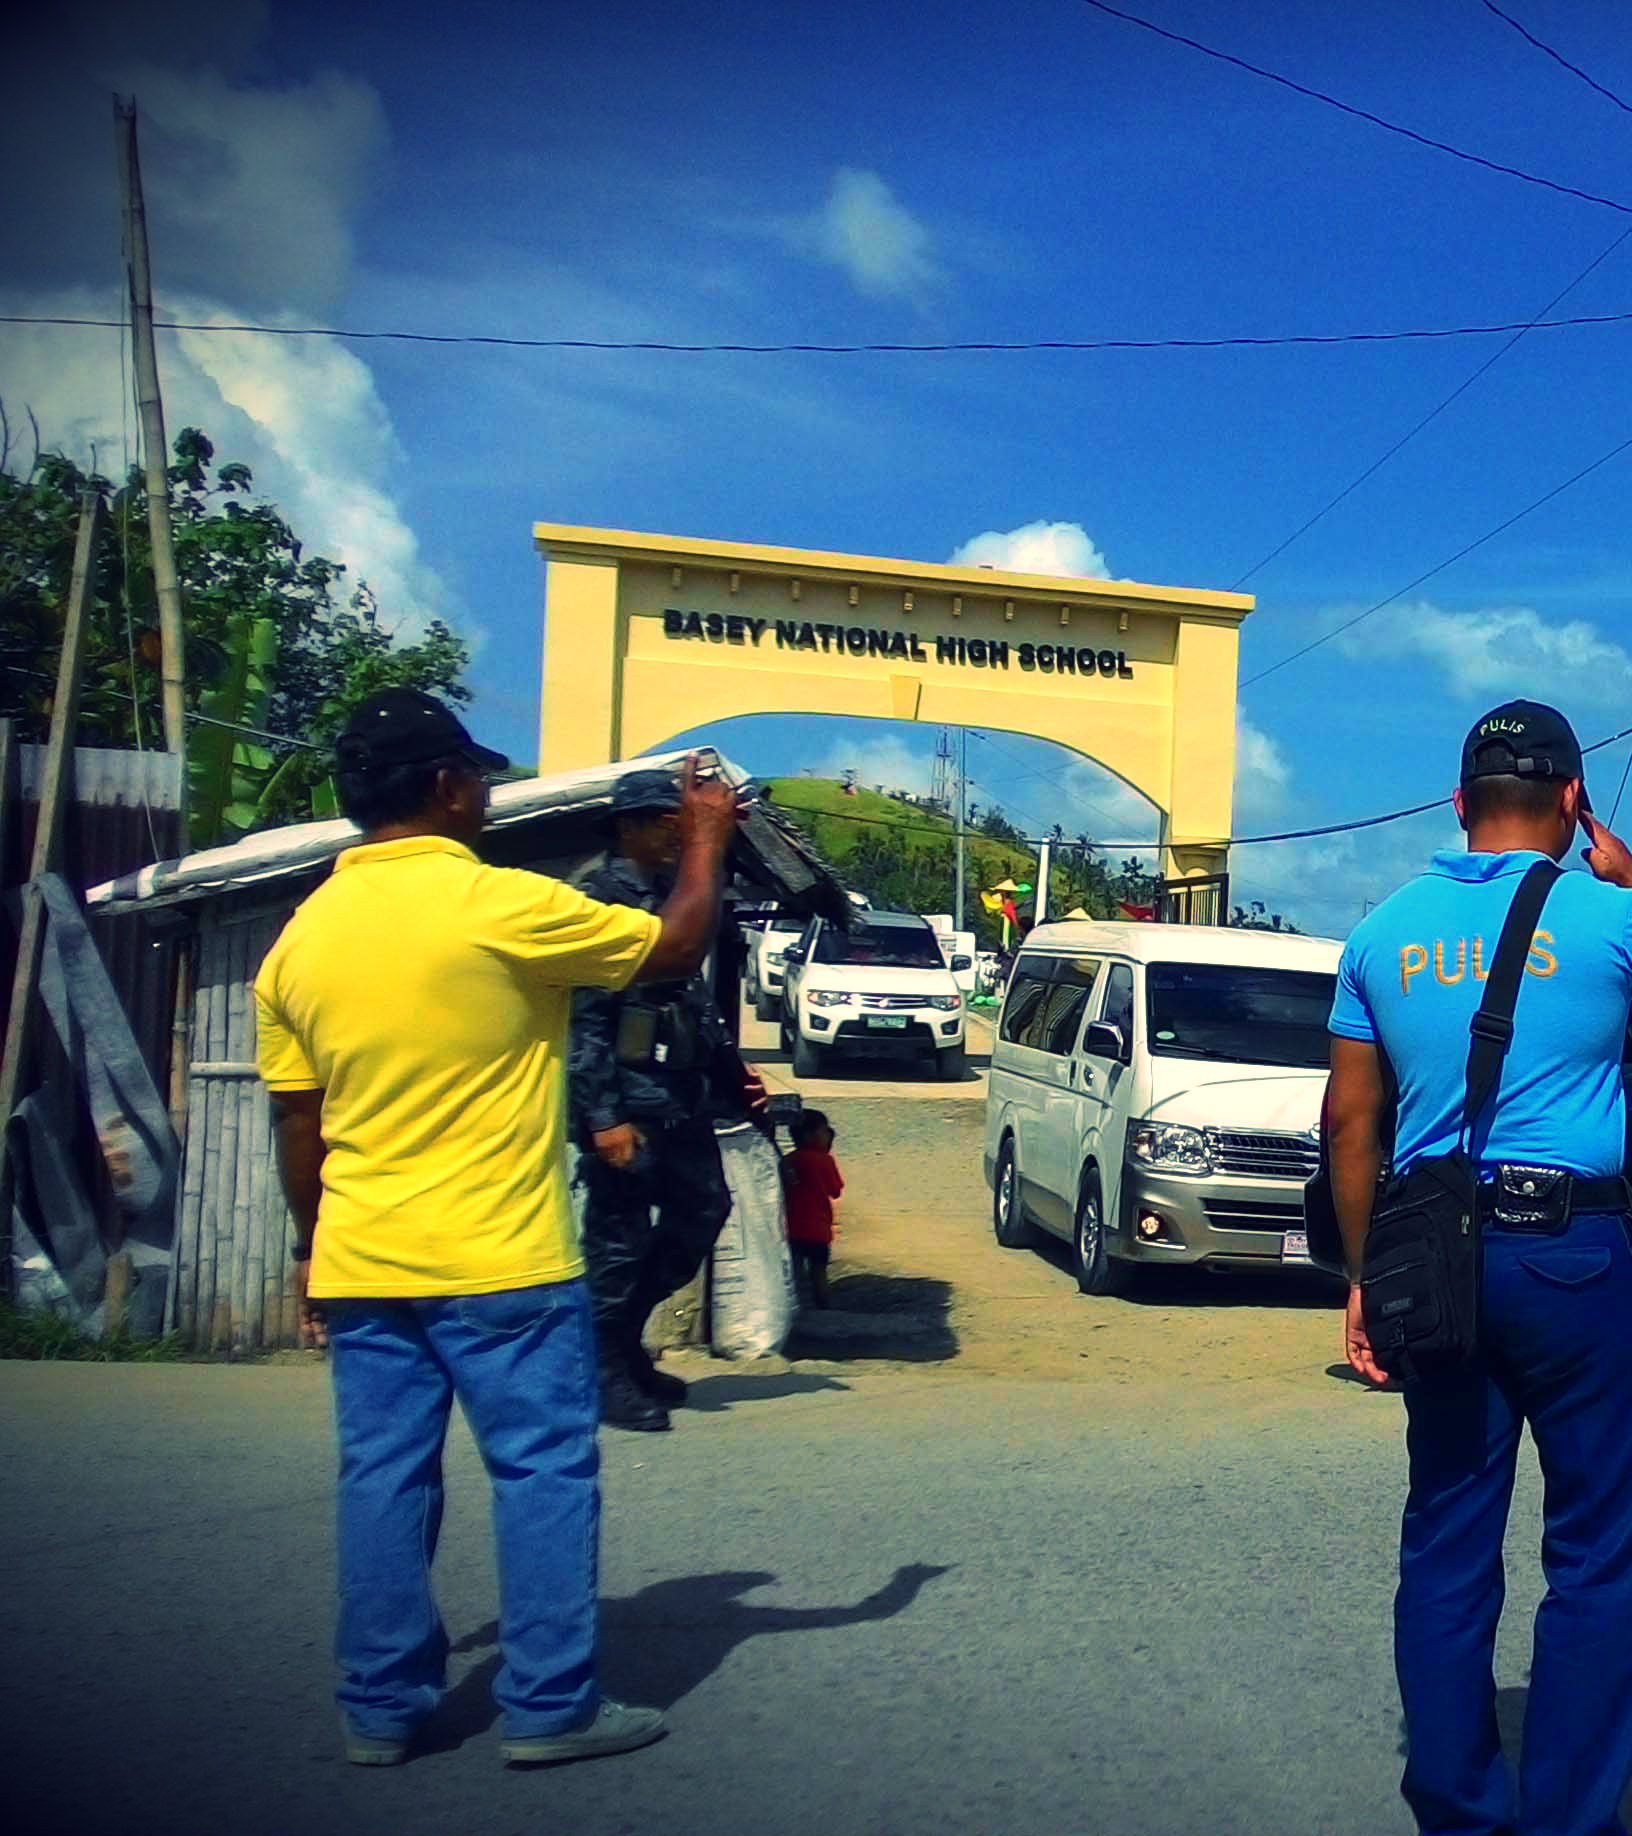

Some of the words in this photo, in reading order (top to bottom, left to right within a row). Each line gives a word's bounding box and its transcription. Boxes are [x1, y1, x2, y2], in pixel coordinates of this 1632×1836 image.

[664, 609, 766, 645] BASEY
[775, 621, 927, 663] NATIONAL
[936, 636, 1009, 669] HIGH
[1017, 643, 1134, 679] SCHOOL
[1479, 719, 1525, 737] PULIS
[1399, 929, 1559, 997] PULS
